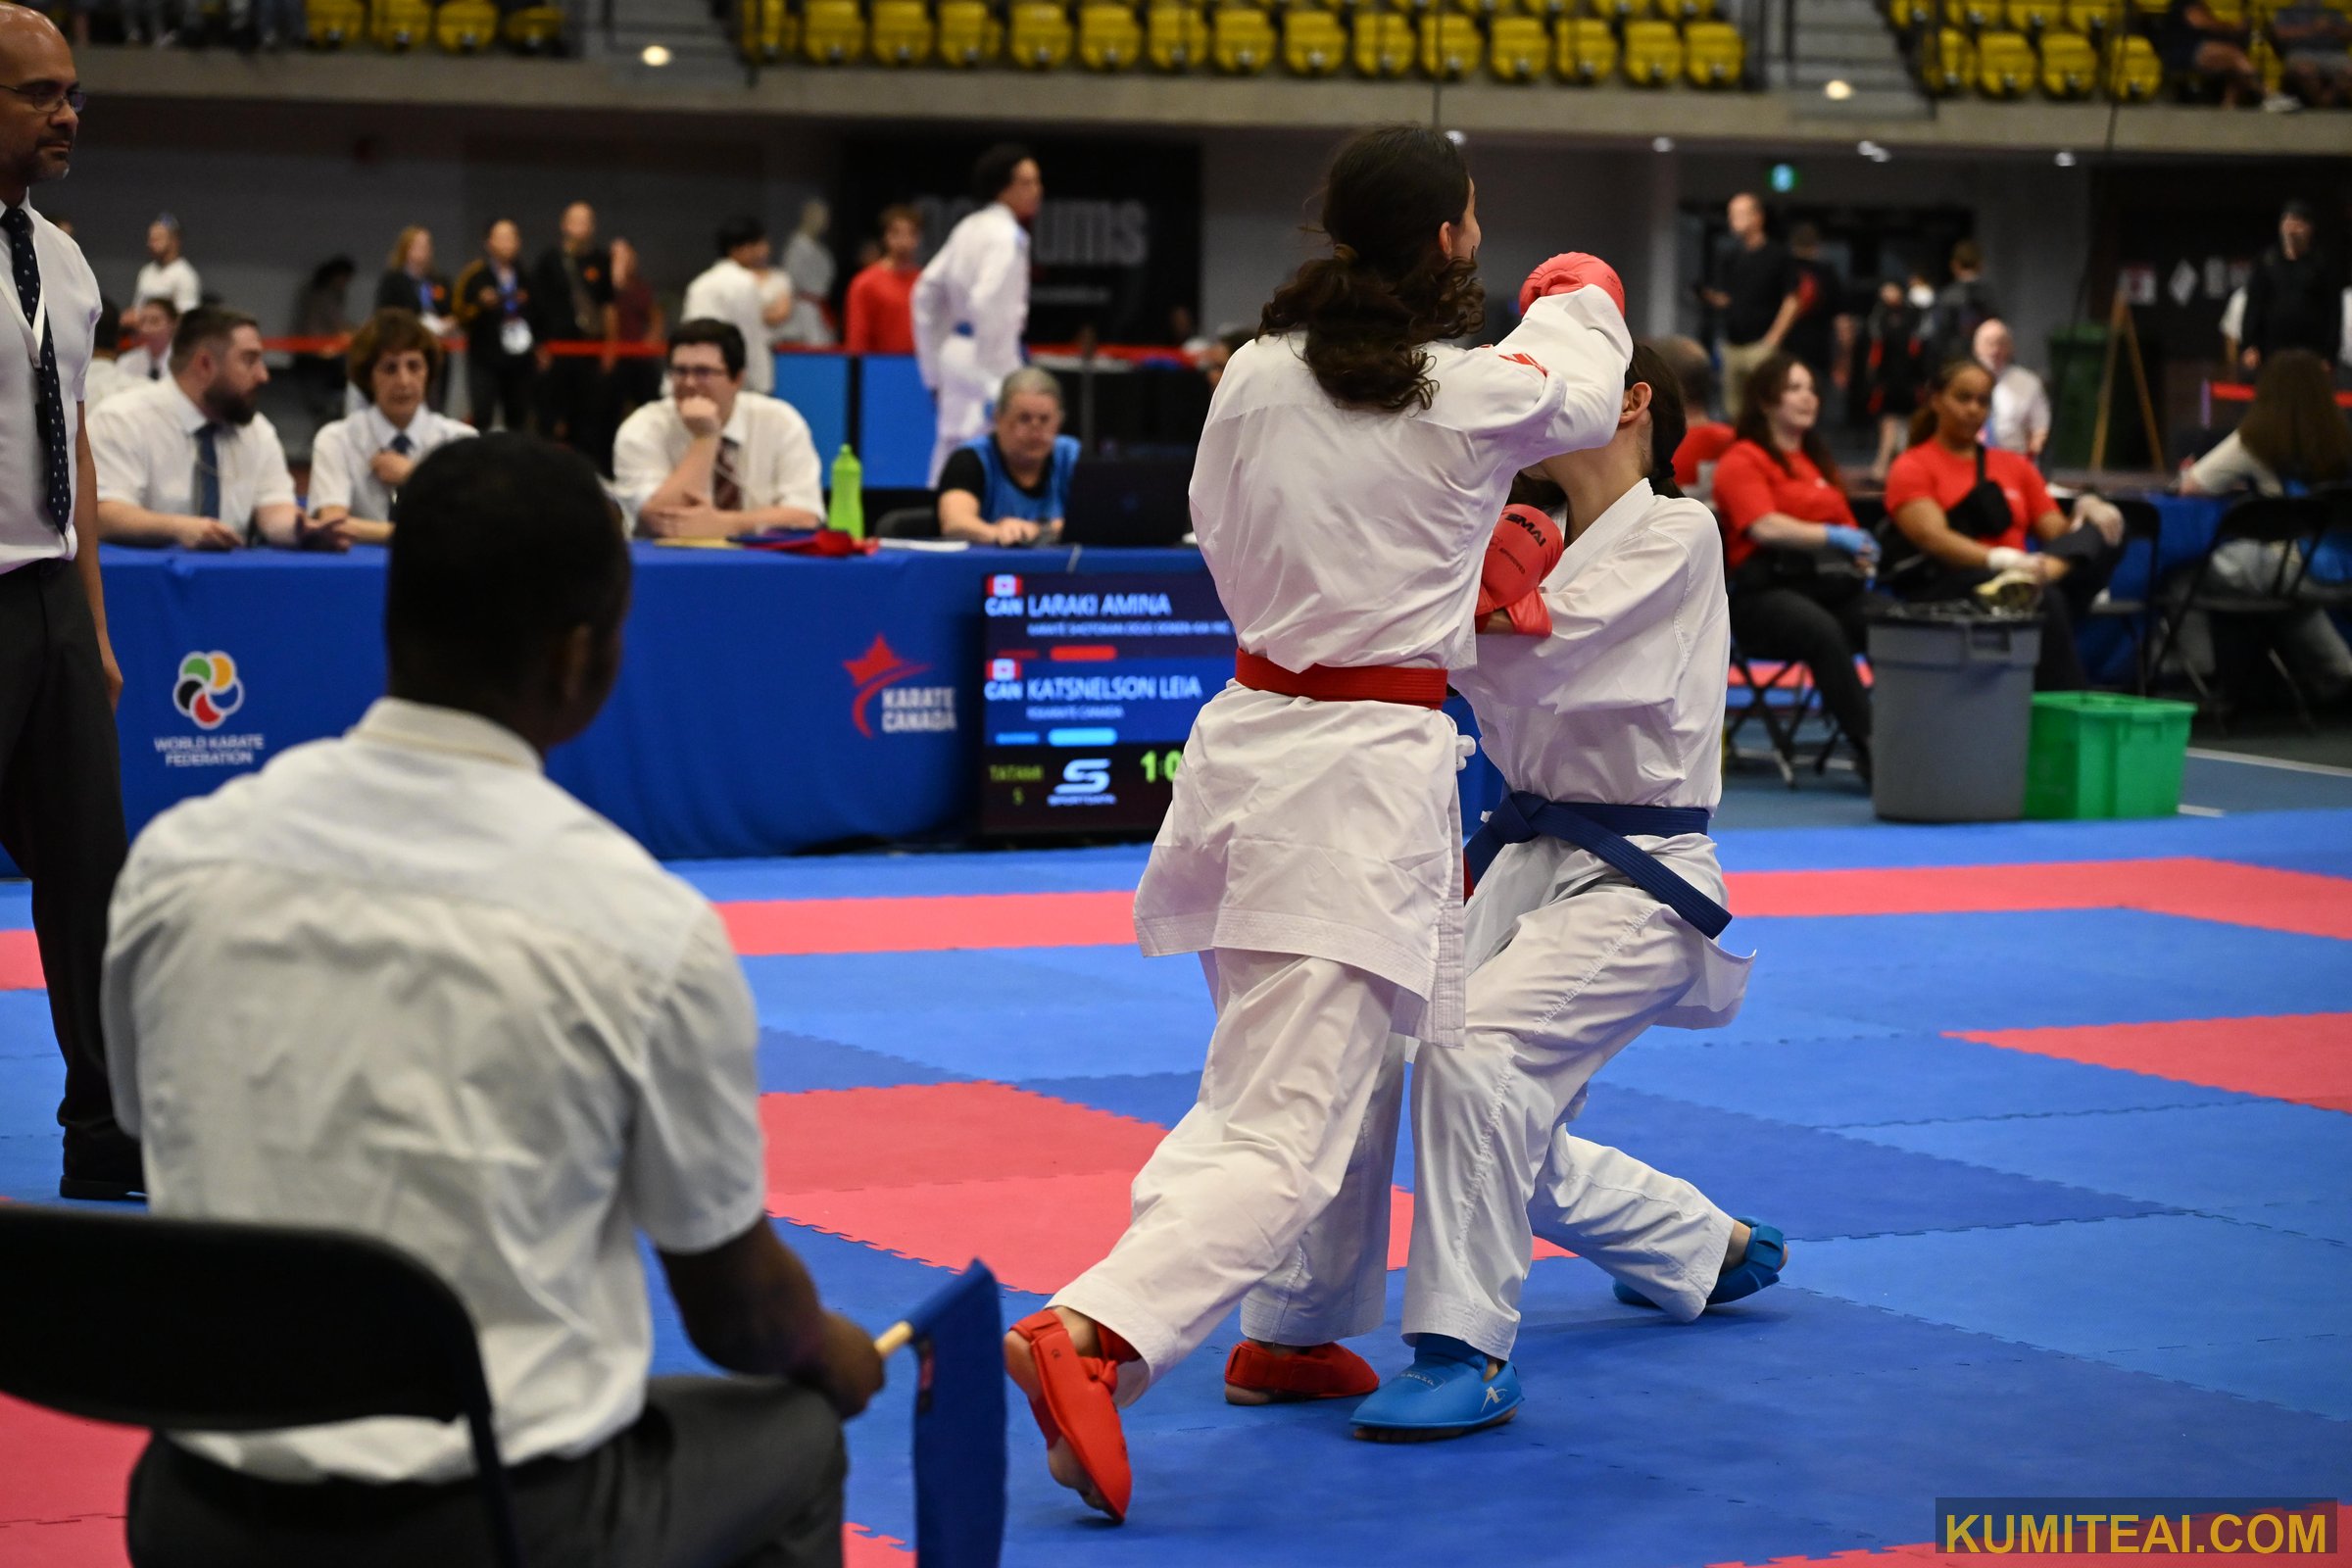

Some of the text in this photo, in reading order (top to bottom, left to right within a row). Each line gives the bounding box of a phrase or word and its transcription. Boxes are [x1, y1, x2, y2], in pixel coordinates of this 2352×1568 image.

[1505, 513, 1546, 546] SMAI
[984, 596, 1024, 617] CAN
[1027, 592, 1172, 618] LARAKI AMINA
[882, 687, 955, 709] KARATE
[984, 680, 1023, 702] CAN
[1158, 675, 1203, 700] LEIA
[882, 710, 957, 733] CANADA
[153, 733, 265, 753] WORLD KARATE
[165, 751, 254, 766] FEDERATION
